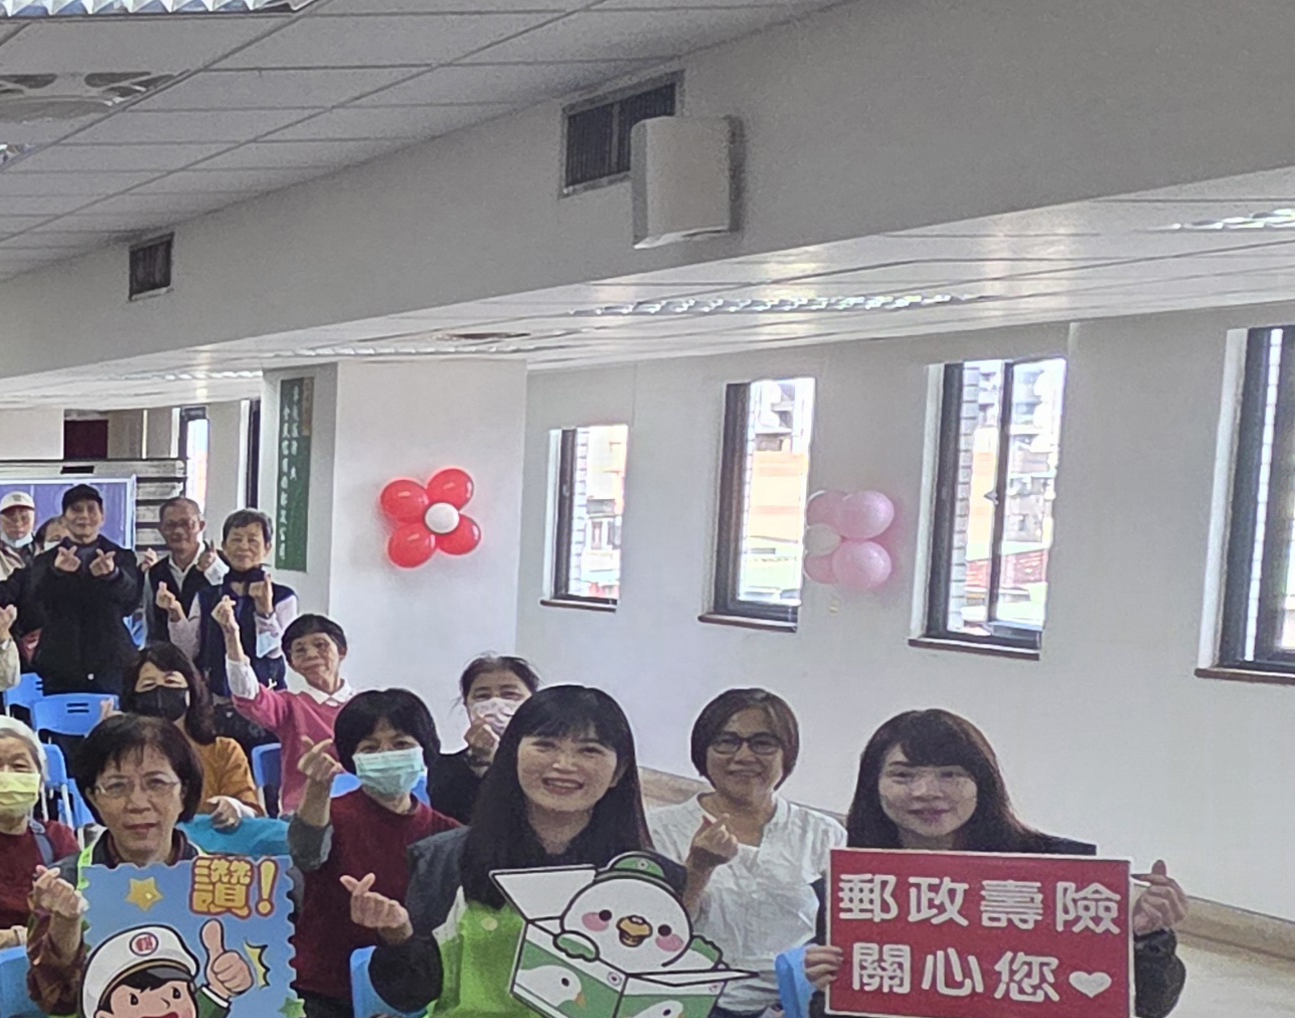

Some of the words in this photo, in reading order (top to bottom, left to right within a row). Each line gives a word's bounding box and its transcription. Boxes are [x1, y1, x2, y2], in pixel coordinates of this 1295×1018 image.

[838, 873, 1122, 935] 郵政壽險
[851, 942, 1061, 1002] 關心您
